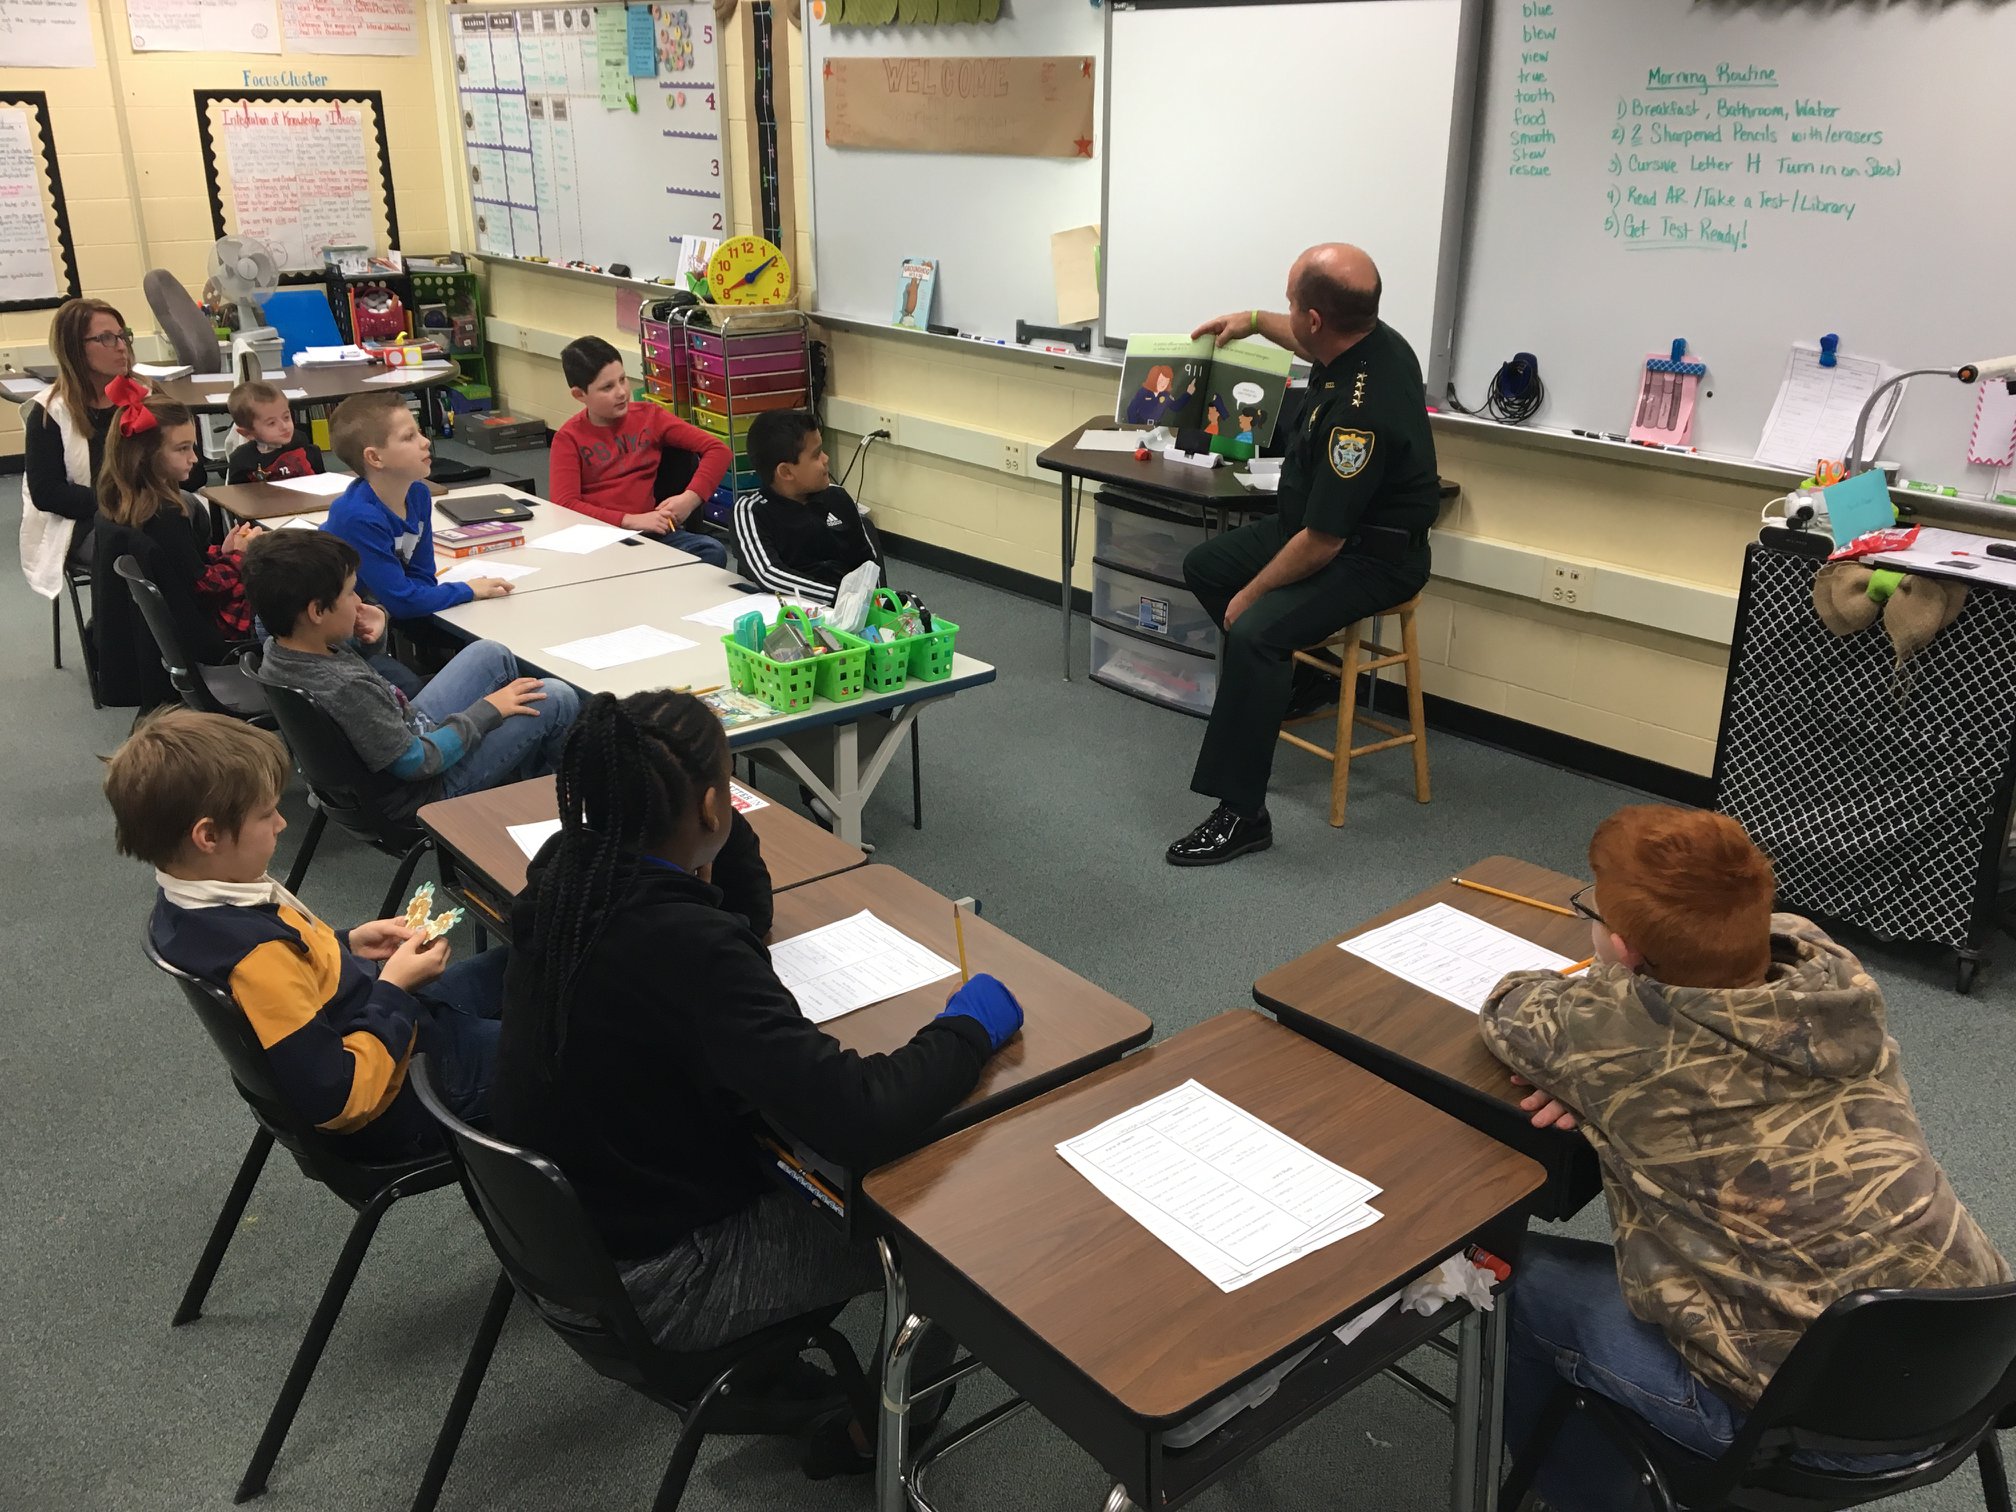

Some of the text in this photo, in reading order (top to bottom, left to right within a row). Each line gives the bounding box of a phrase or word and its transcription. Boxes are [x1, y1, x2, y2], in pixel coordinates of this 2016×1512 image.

[1523, 1, 1553, 18] blue
[704, 26, 712, 44] 5
[1523, 25, 1556, 42] blew
[1522, 51, 1549, 64] view
[242, 70, 328, 86] Focus Cluster
[882, 58, 1010, 98] WELCOME
[1518, 68, 1547, 83] true
[1648, 61, 1776, 95] Morning Routine
[706, 92, 716, 110] 4
[1515, 88, 1554, 103] tooth
[1514, 108, 1546, 125] food
[1717, 98, 1789, 120] Bathroom,
[1796, 98, 1840, 118] Water
[222, 110, 268, 128] Integration
[272, 112, 279, 126] of
[282, 111, 322, 129] Knowledge
[330, 110, 356, 126] Ideas
[1650, 122, 1722, 147] Sharpened
[1734, 122, 1777, 143] Pencils
[711, 159, 719, 176] 3
[1510, 164, 1551, 176] rescue
[1629, 154, 1678, 173] Cursive
[1690, 155, 1734, 172] Letter
[1747, 152, 1760, 174] H
[1777, 157, 1814, 174] Turn
[1820, 164, 1836, 176] in
[1841, 166, 1860, 176] on
[1628, 186, 1656, 206] Read
[1665, 185, 1688, 204] AR
[1744, 197, 1752, 208] a
[712, 213, 722, 230] 2
[1624, 214, 1650, 238] Get
[1660, 216, 1694, 240] Test
[1700, 217, 1748, 252] Ready!
[728, 247, 739, 258] 11
[741, 242, 754, 254] 12
[760, 246, 766, 257] 1
[718, 260, 731, 272] 10
[771, 256, 778, 268] 2
[716, 274, 724, 285] 9
[777, 272, 785, 283] 3
[723, 288, 730, 299] 8
[773, 288, 780, 298] 4
[1184, 364, 1202, 377] 911
